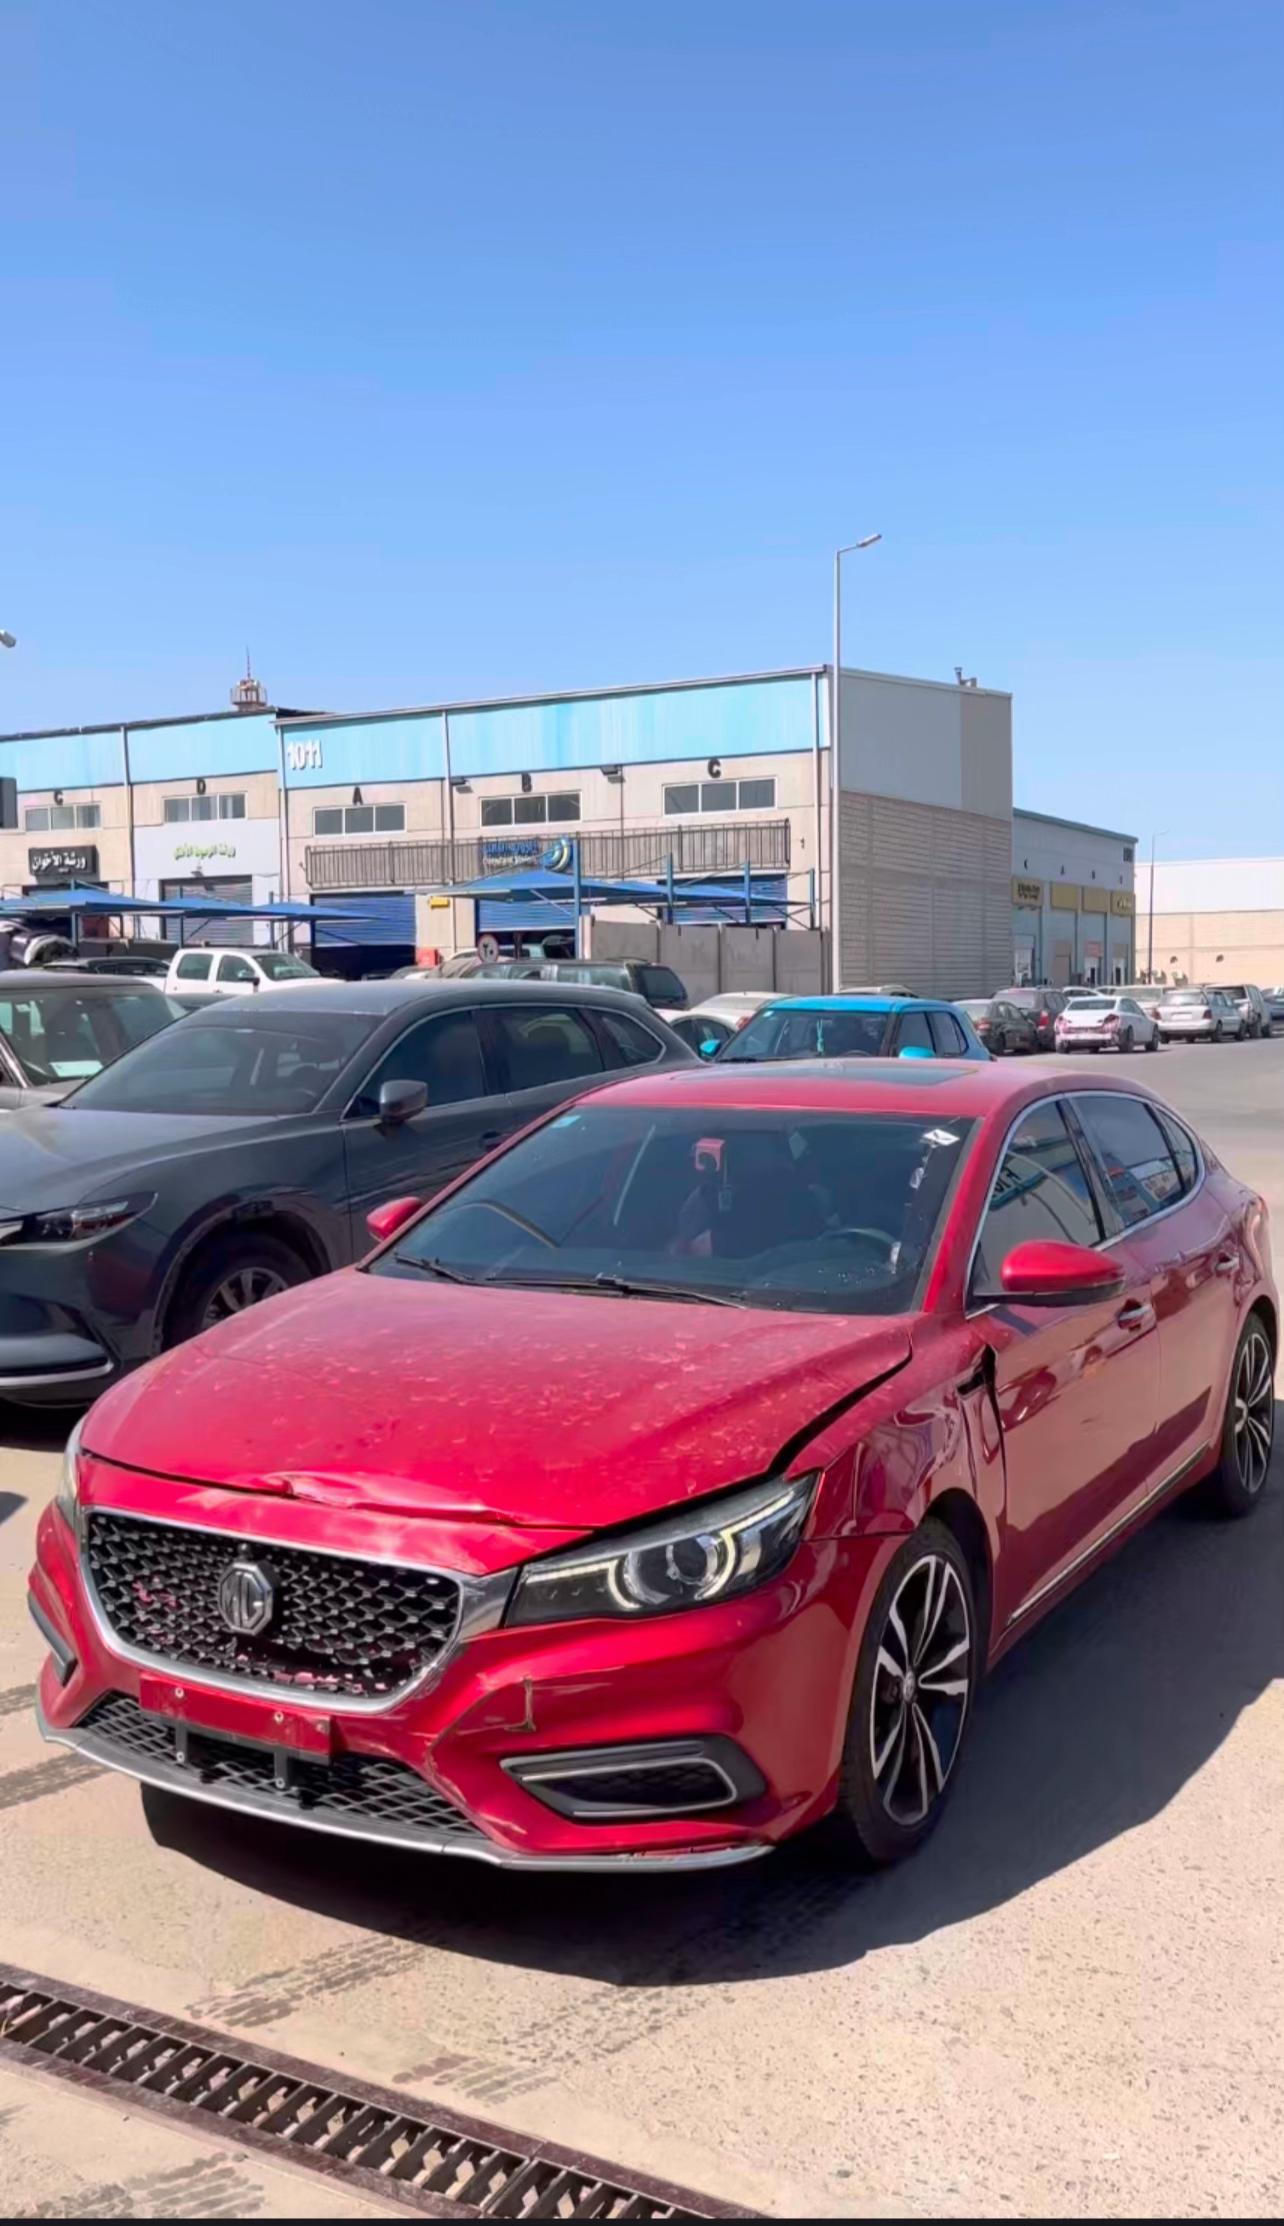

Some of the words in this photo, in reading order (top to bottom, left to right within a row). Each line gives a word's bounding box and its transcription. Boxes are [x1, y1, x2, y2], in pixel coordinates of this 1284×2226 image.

[286, 741, 323, 770] 1011
[708, 758, 721, 778] C
[196, 779, 206, 795] D
[352, 785, 364, 806] A
[54, 790, 63, 805] C
[63, 851, 86, 869] ورشة
[222, 1570, 264, 1630] MG
